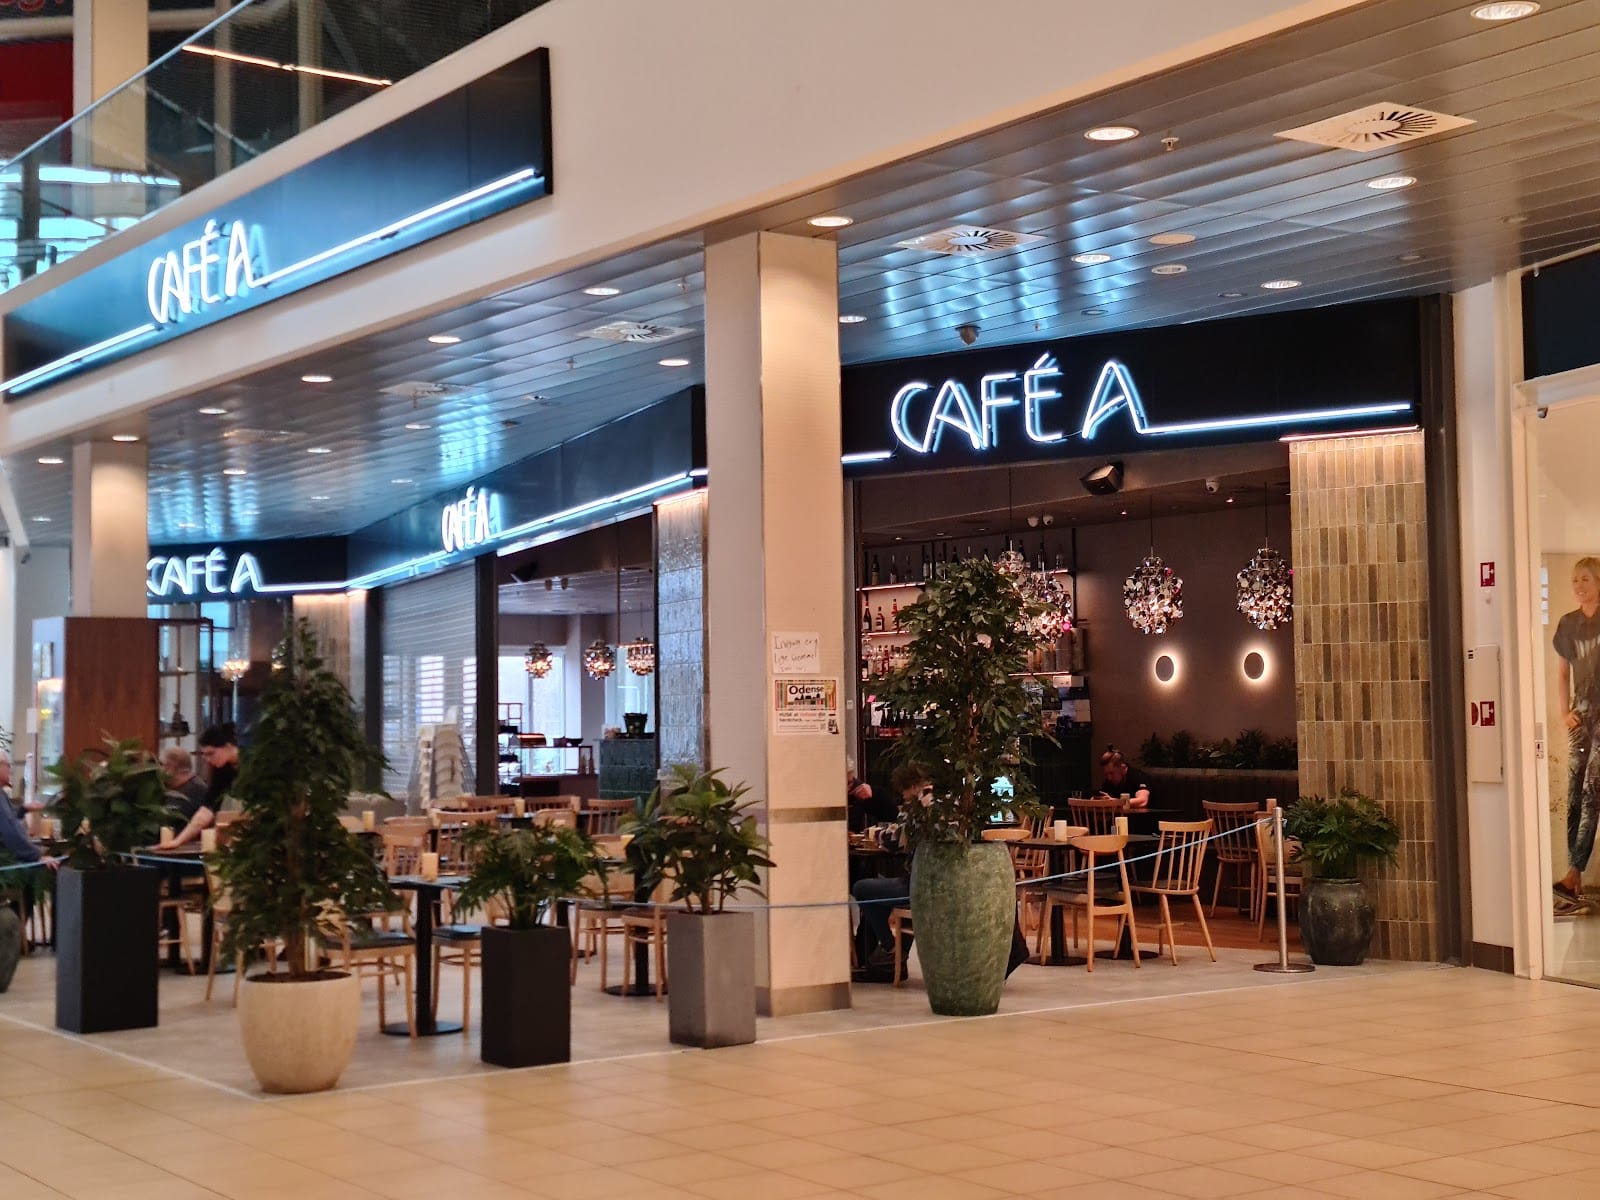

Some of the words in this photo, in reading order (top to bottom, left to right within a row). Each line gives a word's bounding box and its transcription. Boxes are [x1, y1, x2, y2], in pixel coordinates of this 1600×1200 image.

[147, 218, 221, 324] CAFÉ
[224, 219, 257, 297] A
[889, 352, 1064, 453] CAFÉ
[1080, 360, 1147, 440] A
[441, 485, 477, 553] CAFÉ
[146, 546, 228, 596] CAFÉ
[230, 552, 262, 593] A
[788, 685, 825, 695] Odense
